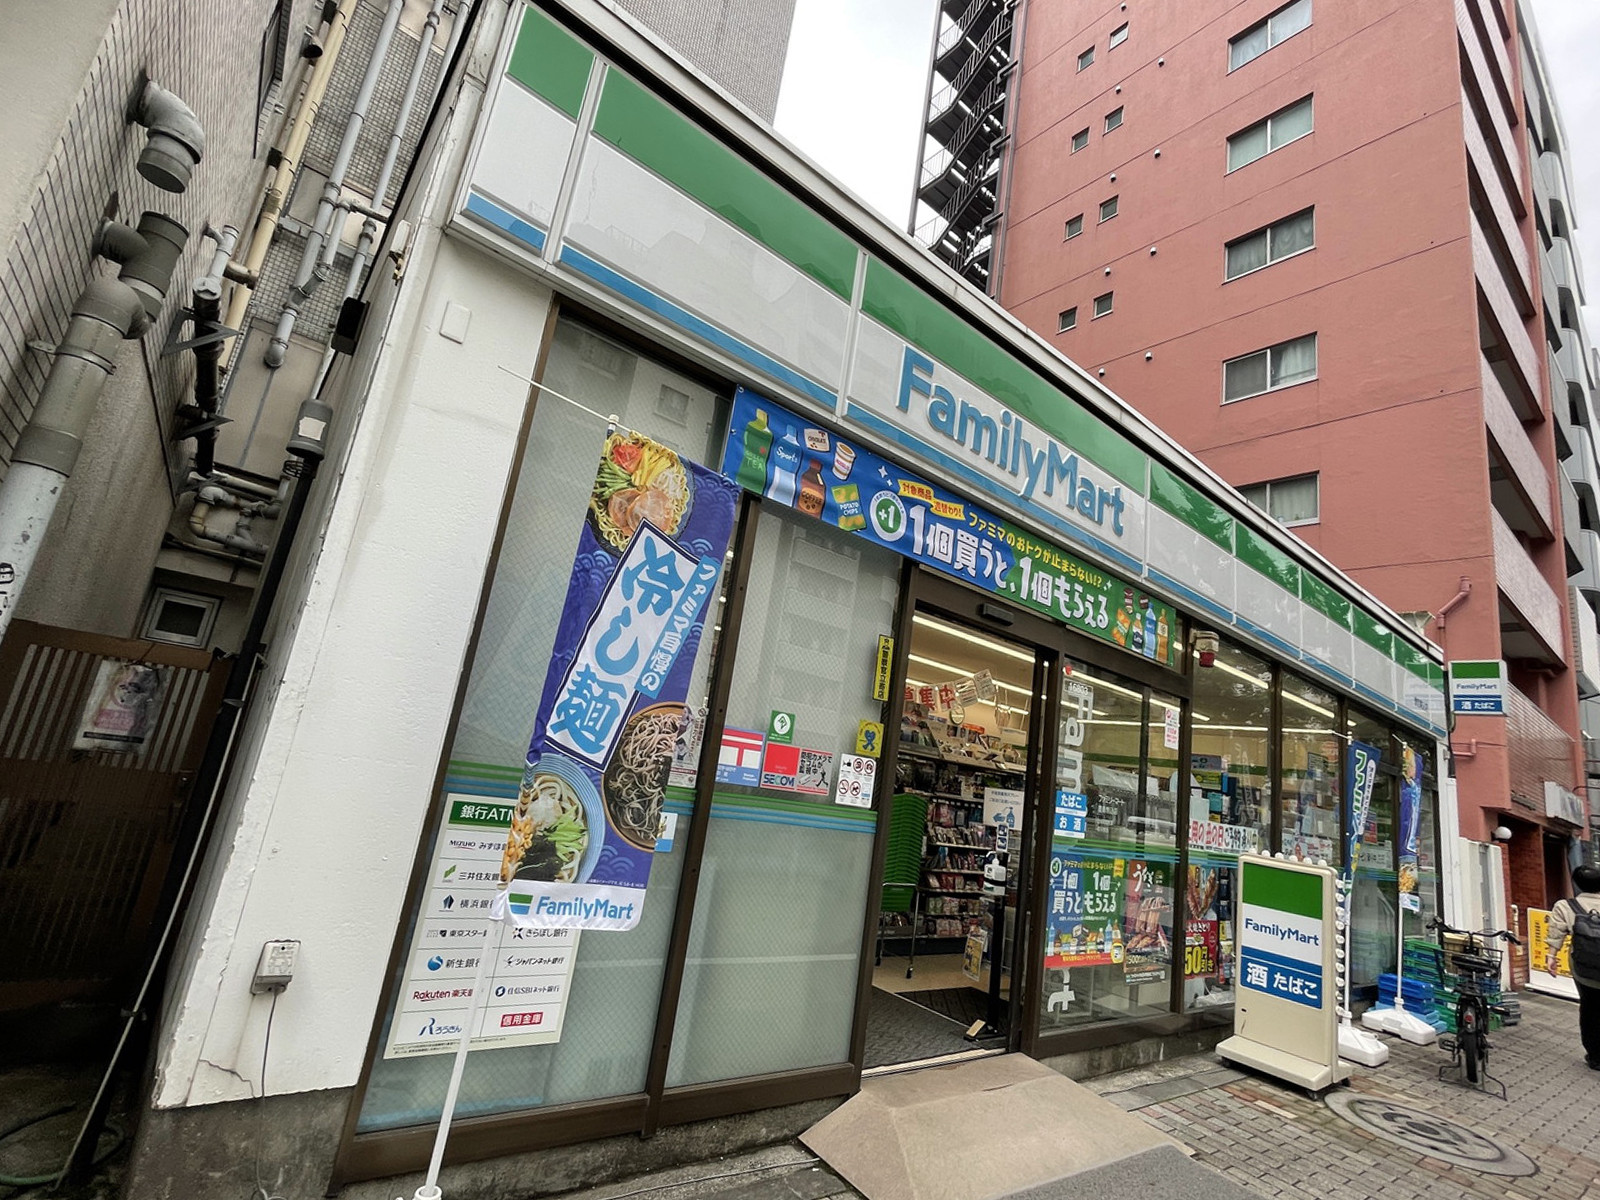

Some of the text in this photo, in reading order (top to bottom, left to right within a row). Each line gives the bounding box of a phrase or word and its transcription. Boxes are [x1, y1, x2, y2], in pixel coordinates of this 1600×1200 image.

[896, 344, 1125, 538] FamilyMart
[776, 446, 798, 463] Sports
[746, 457, 765, 472] TEA
[550, 535, 686, 754] 冷し麺
[1461, 701, 1496, 710] 酒 たばこ
[763, 773, 795, 787] SECOM
[1061, 793, 1082, 808] たばこ
[536, 896, 634, 920] FamilyMart
[1084, 891, 1117, 914] もらえる
[449, 929, 487, 938] 東京スター
[1244, 917, 1320, 947] FamilyMart
[1246, 961, 1318, 1000] 酒 たばこ
[413, 990, 451, 1002] Rakuten
[502, 1013, 543, 1026] 信用金庫
